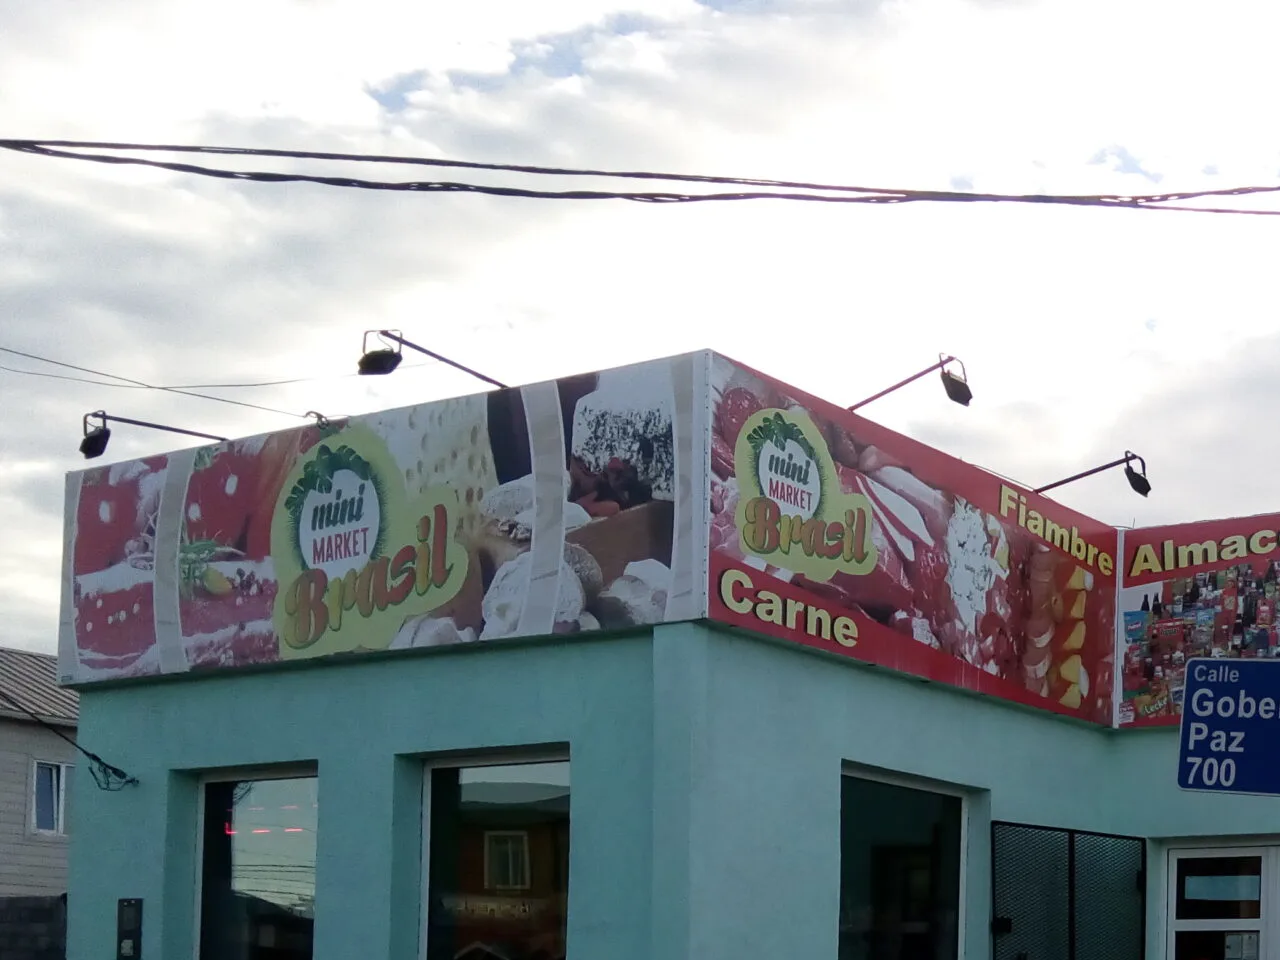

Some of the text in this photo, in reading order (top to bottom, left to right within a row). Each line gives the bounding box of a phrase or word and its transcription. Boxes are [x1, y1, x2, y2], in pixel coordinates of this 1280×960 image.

[768, 453, 811, 488] mini
[311, 489, 366, 532] mini
[768, 477, 814, 512] MARKET
[311, 526, 370, 566] MARKET
[742, 497, 872, 564] Brasil
[999, 484, 1114, 578] Fiambre
[283, 504, 454, 651] Brasil
[719, 568, 860, 649] Carne
[1194, 664, 1240, 683] Calle
[1188, 722, 1245, 755] Paz
[1185, 757, 1237, 788] 700
